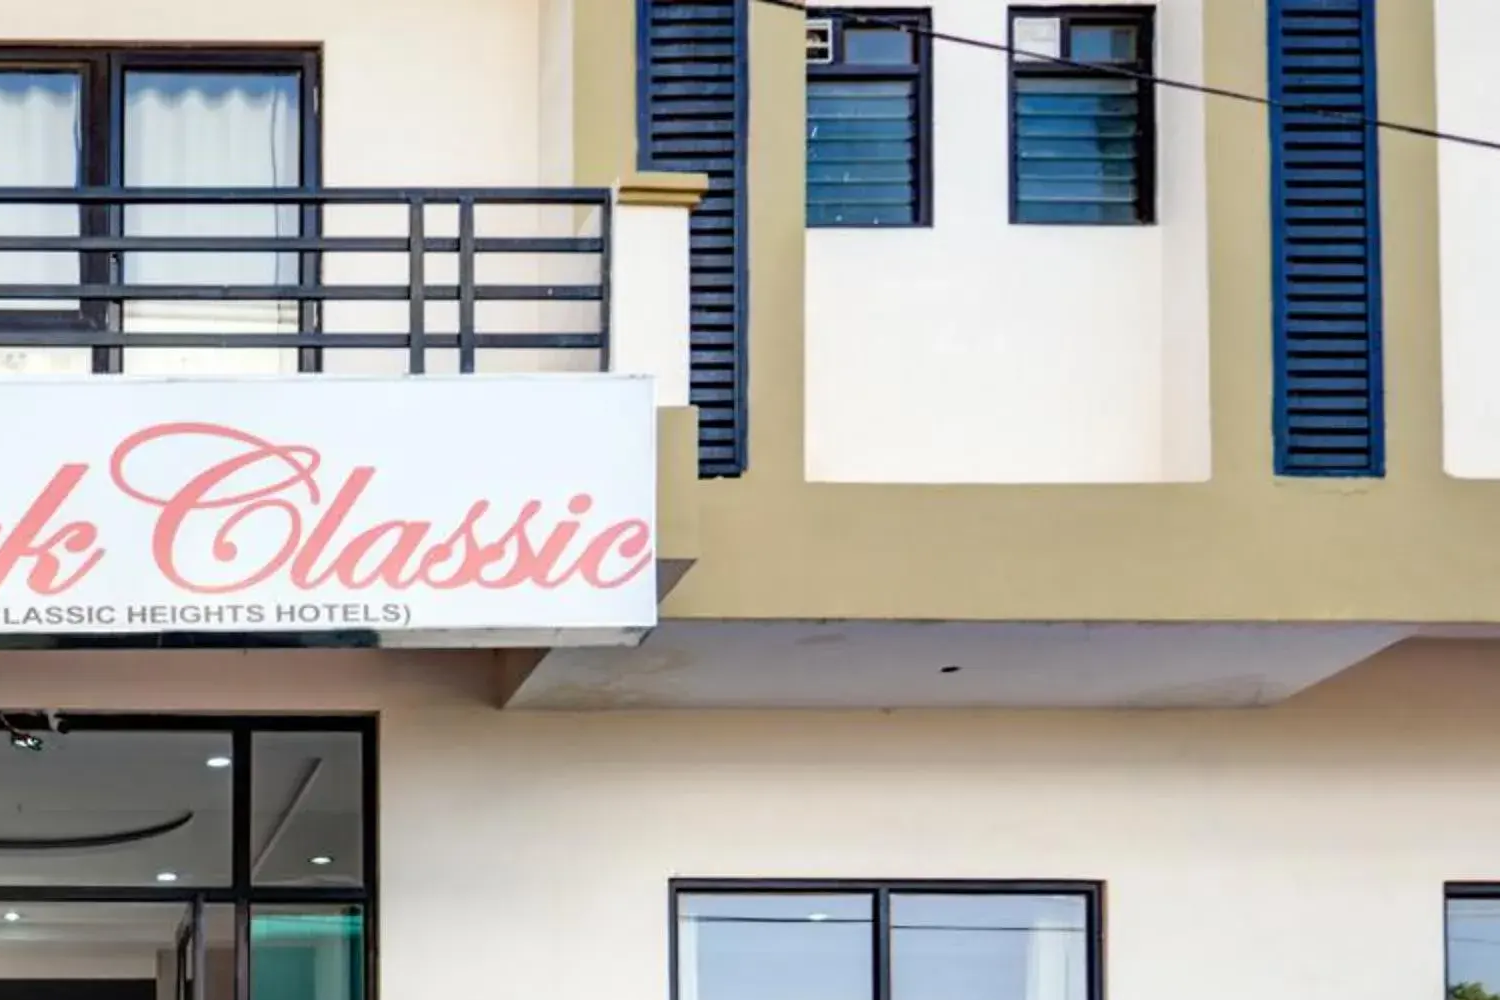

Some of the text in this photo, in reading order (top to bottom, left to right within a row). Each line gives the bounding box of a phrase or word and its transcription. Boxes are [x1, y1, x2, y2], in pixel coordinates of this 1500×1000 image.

[109, 421, 654, 595] Classic
[126, 603, 266, 625] HEIGHTS
[275, 602, 412, 626] HOTELS)
